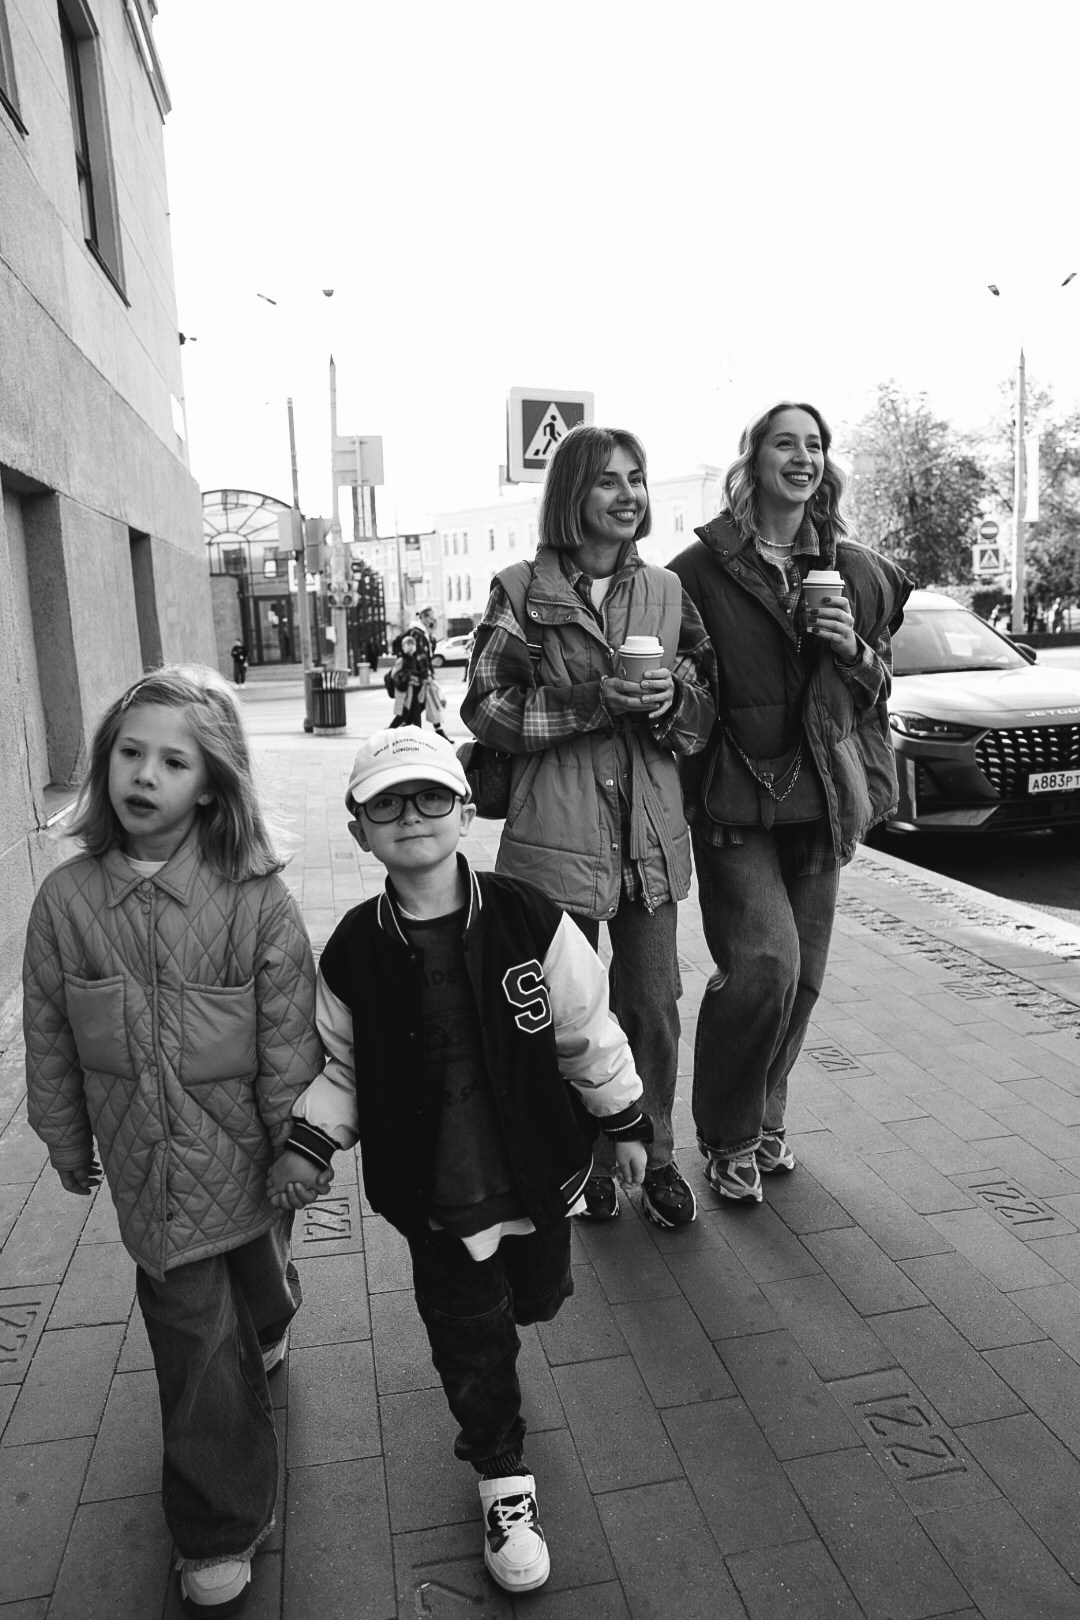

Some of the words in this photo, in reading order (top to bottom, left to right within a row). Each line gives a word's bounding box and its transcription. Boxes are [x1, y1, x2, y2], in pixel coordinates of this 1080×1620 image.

[1025, 707, 1080, 717] JETOU
[392, 746, 420, 754] LONDON
[502, 959, 552, 1034] S
